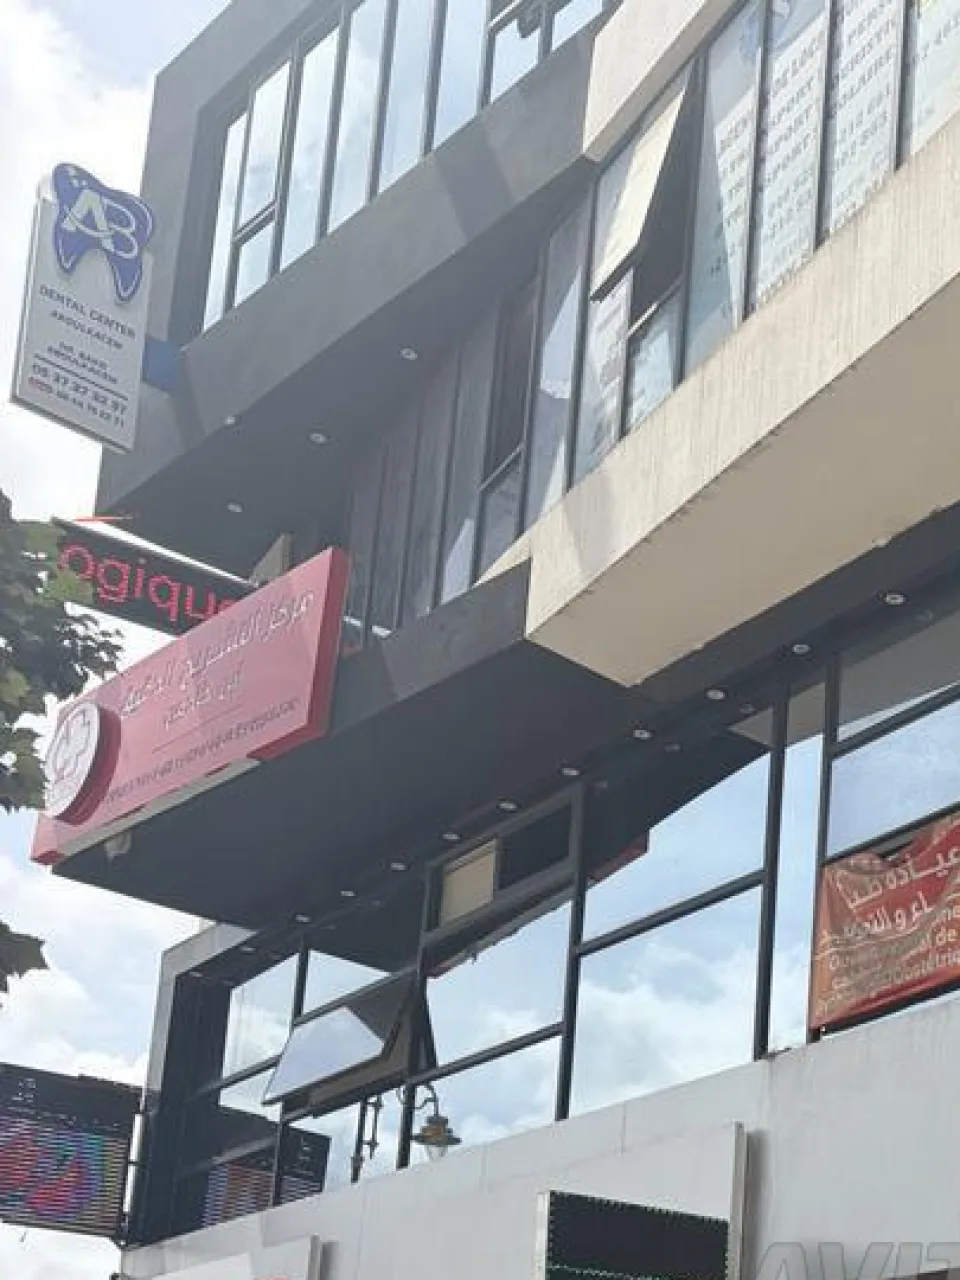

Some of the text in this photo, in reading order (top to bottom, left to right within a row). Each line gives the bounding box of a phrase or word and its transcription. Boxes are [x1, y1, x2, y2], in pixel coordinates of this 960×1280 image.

[39, 284, 137, 339] DENTAL CENTER
[935, 926, 958, 948] de
